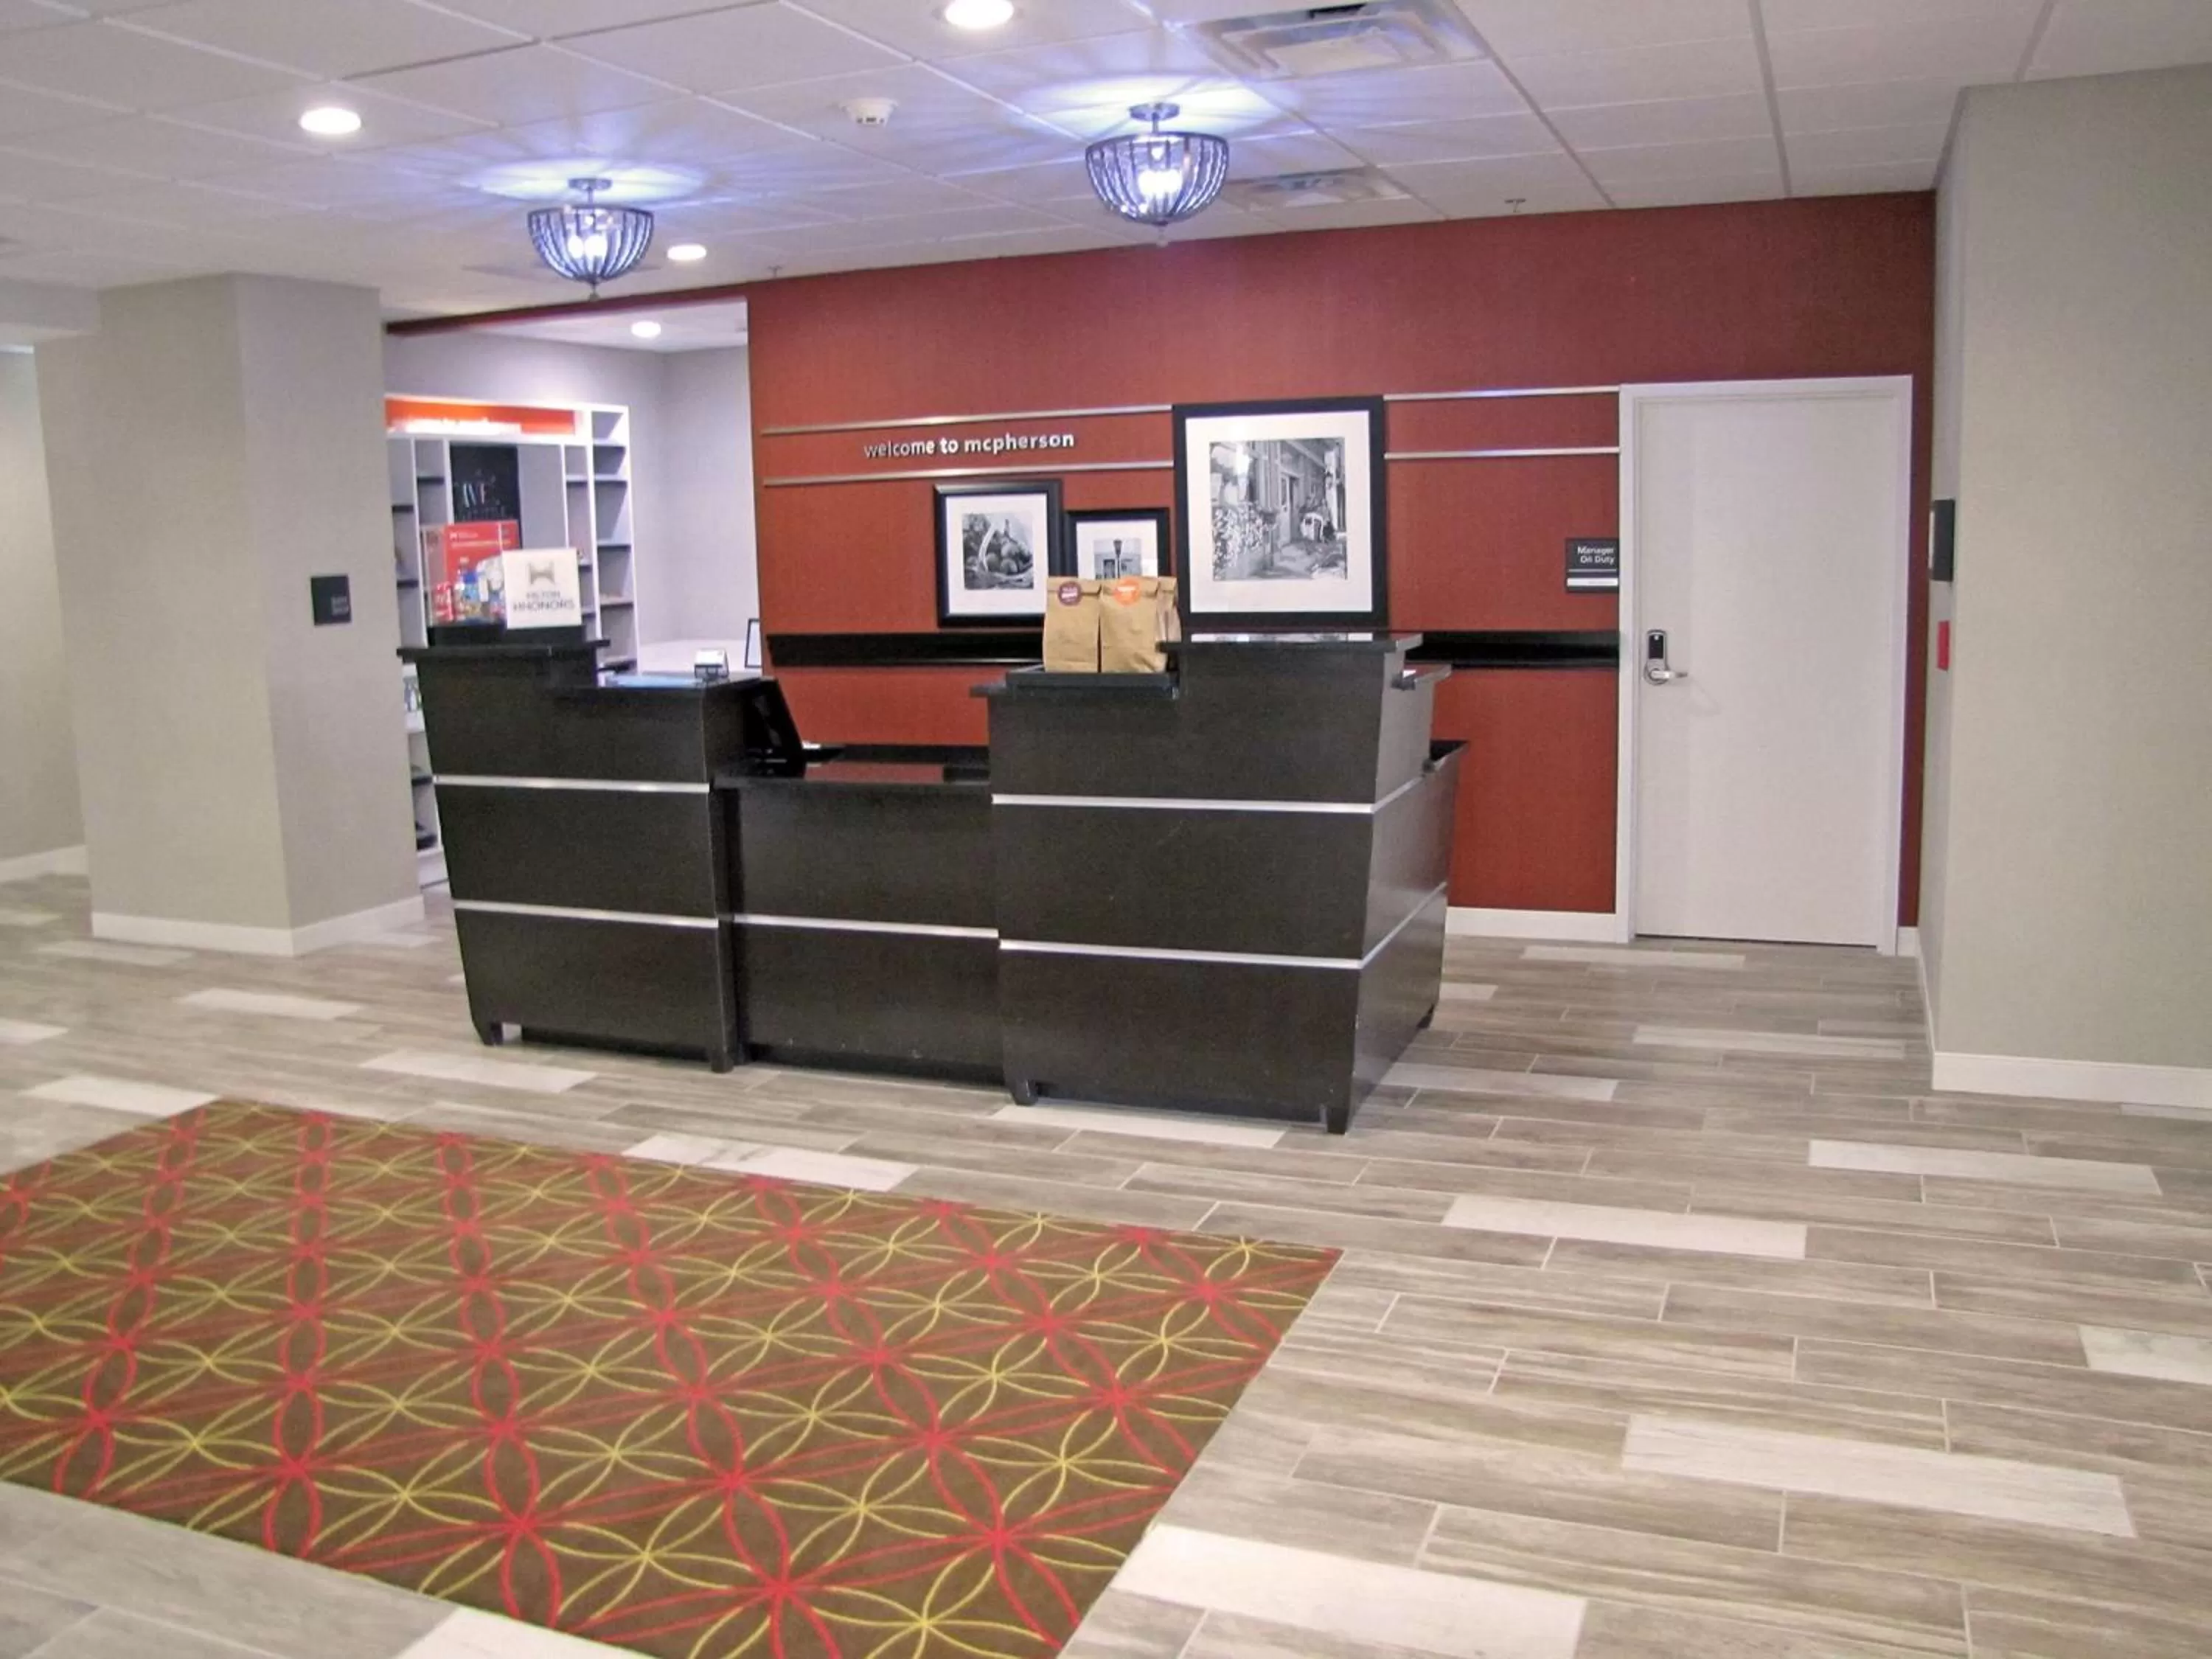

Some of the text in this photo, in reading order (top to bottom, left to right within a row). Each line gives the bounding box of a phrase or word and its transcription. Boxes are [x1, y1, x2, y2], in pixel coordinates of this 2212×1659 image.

[863, 432, 1075, 459] welcome to mcpherson
[1577, 546, 1614, 555] Manager
